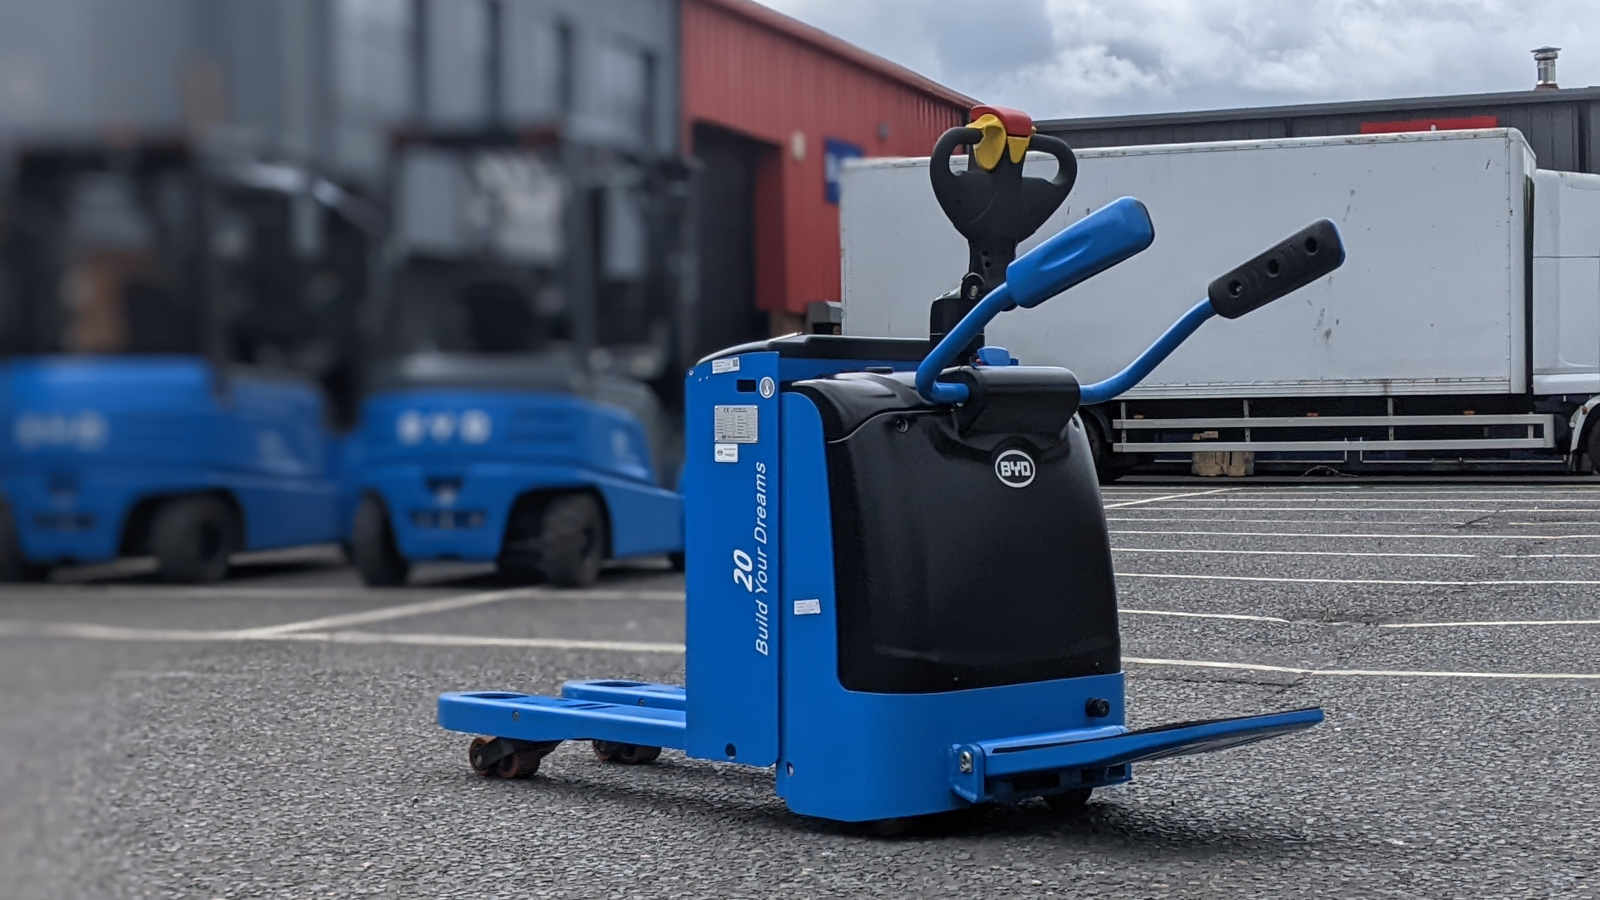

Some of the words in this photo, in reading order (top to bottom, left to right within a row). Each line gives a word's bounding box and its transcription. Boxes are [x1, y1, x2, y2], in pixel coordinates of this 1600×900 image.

[1000, 461, 1031, 477] BYD
[754, 461, 767, 545] Dreams
[733, 549, 753, 593] 20
[755, 546, 768, 594] Your
[755, 600, 768, 656] Build
